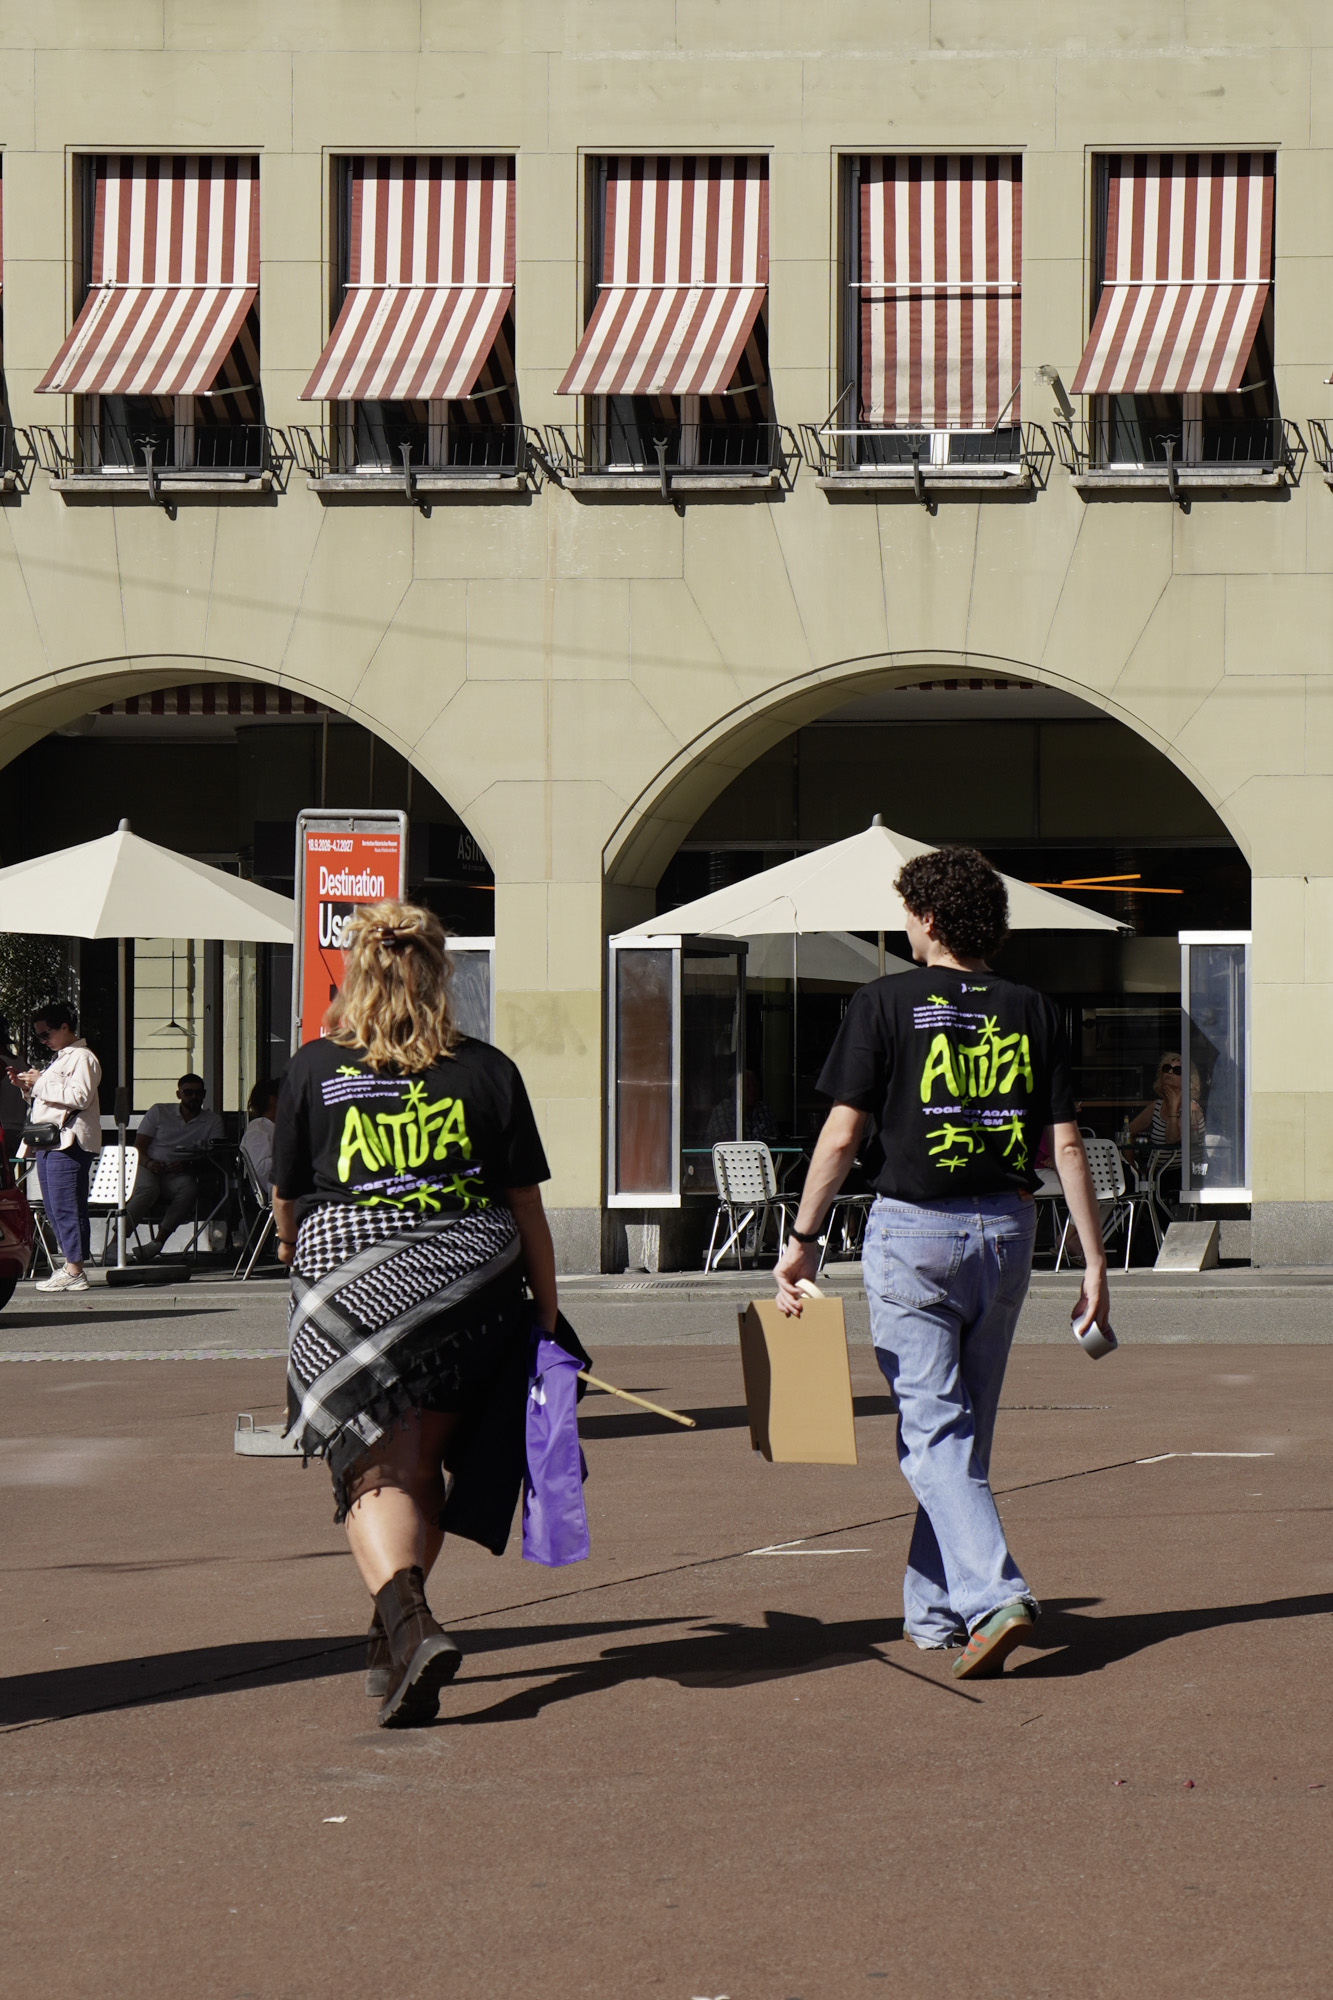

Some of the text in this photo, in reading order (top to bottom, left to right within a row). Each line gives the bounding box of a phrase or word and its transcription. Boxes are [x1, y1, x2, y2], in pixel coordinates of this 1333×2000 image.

[319, 866, 385, 897] Destination
[920, 1033, 1034, 1104] ANTIFA
[337, 1097, 472, 1183] ANTIFA
